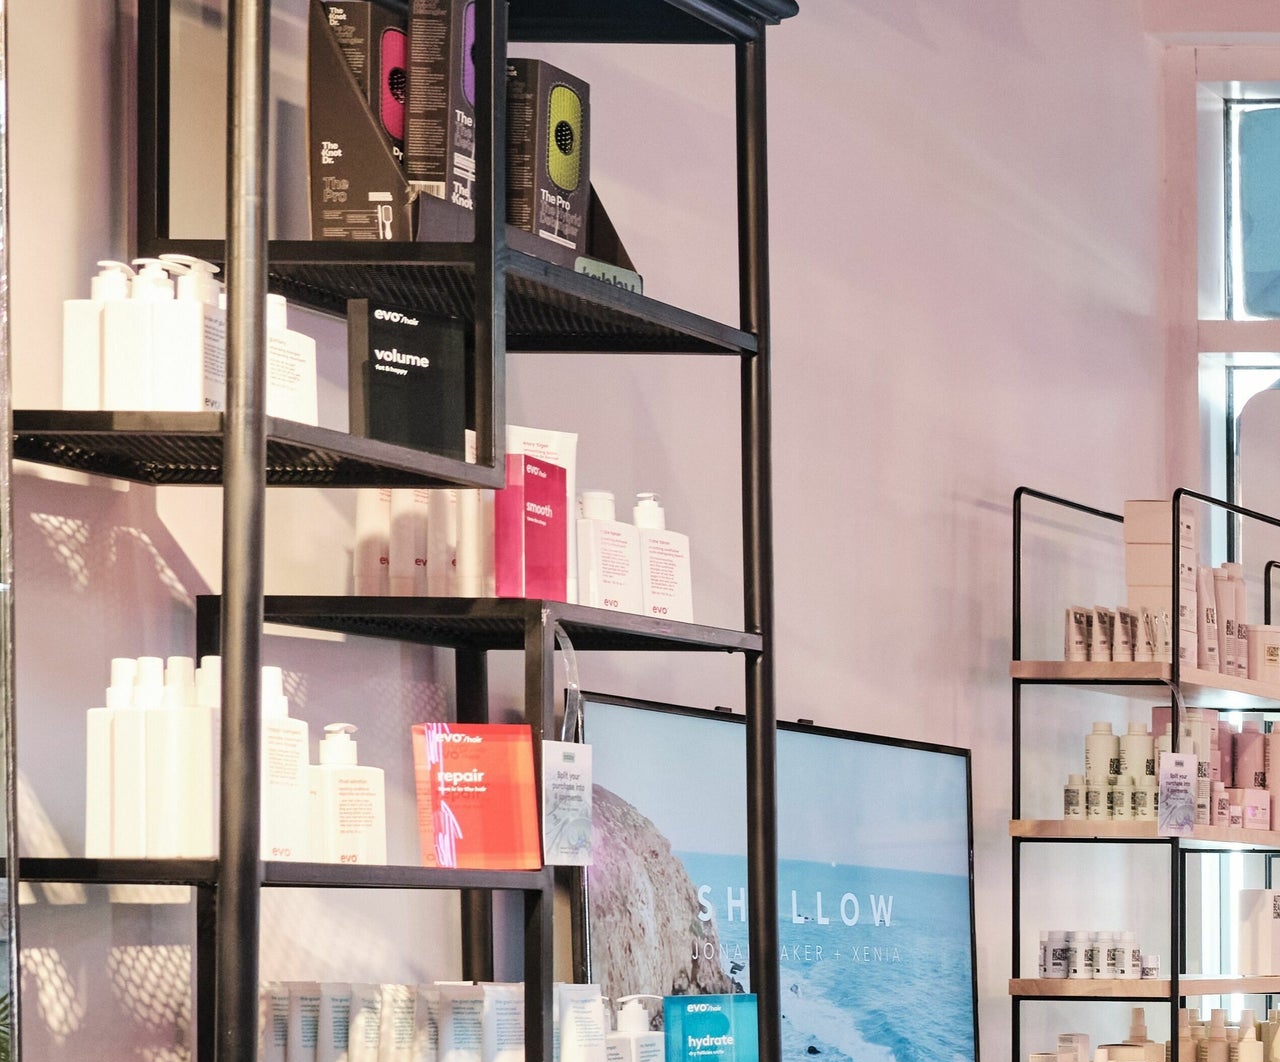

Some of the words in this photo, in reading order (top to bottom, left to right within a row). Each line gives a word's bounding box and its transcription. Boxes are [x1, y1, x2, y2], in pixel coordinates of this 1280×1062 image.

[455, 109, 473, 127] The
[321, 142, 338, 150] The
[321, 149, 342, 157] Knot
[321, 156, 335, 164] Dr.
[323, 177, 349, 190] The
[453, 181, 470, 198] The
[323, 189, 348, 203] Pro
[451, 193, 474, 210] Knot
[540, 188, 556, 205] The
[556, 195, 571, 211] Pro
[374, 348, 430, 368] volume
[526, 501, 553, 518] smooth
[415, 558, 428, 567] ev
[604, 599, 619, 607] evo
[652, 606, 668, 614] evo
[437, 768, 485, 785] repair
[569, 773, 580, 781] your
[340, 854, 358, 863] evo
[697, 884, 894, 927] SHLLOW
[780, 945, 824, 962] AKER
[852, 946, 901, 962] XENIA
[688, 1035, 734, 1050] hydrate
